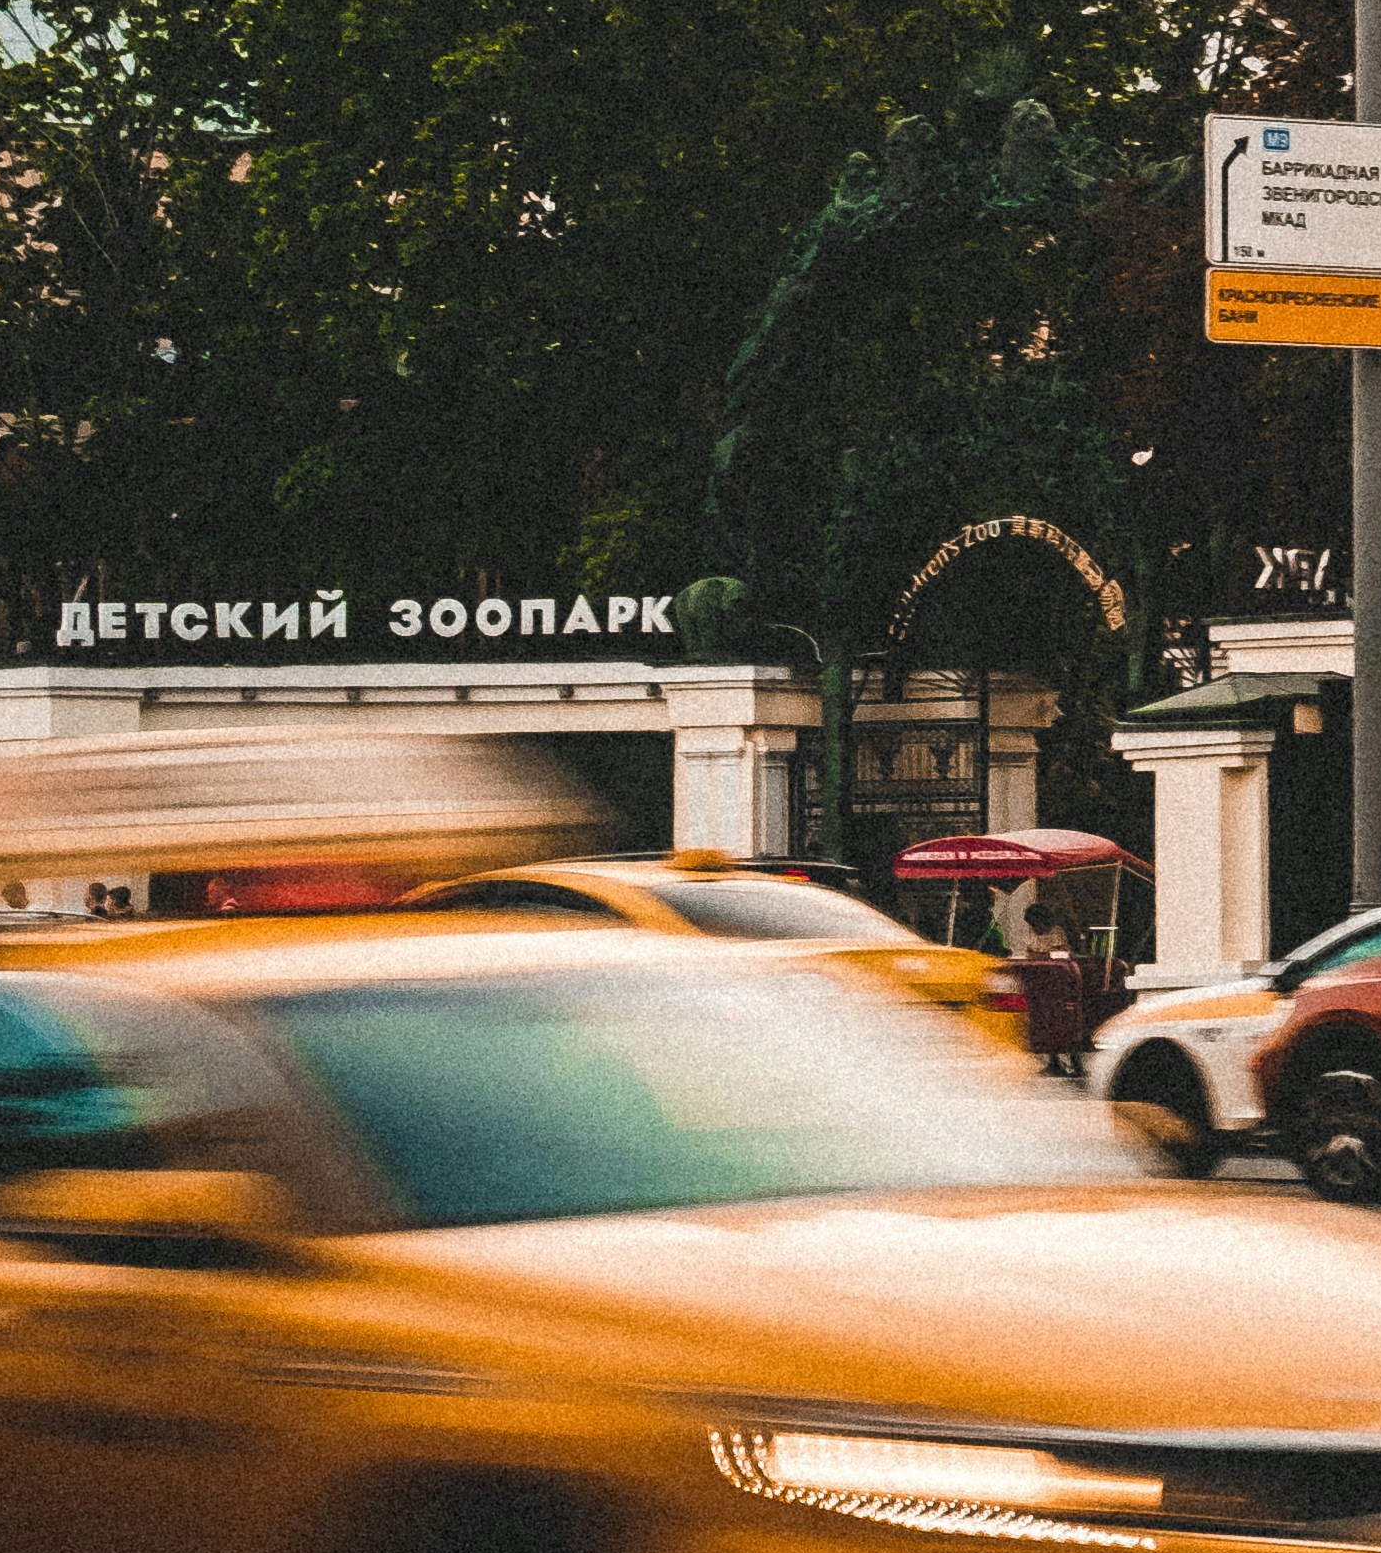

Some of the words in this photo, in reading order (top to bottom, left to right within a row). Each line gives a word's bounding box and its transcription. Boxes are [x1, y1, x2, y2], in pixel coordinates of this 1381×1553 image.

[1262, 160, 1380, 181] БАРРИКАДНАЯ
[1262, 210, 1307, 230] МКАД
[56, 589, 348, 647] ДЕТСКИЙ
[388, 594, 675, 638] ЗООПАРК
